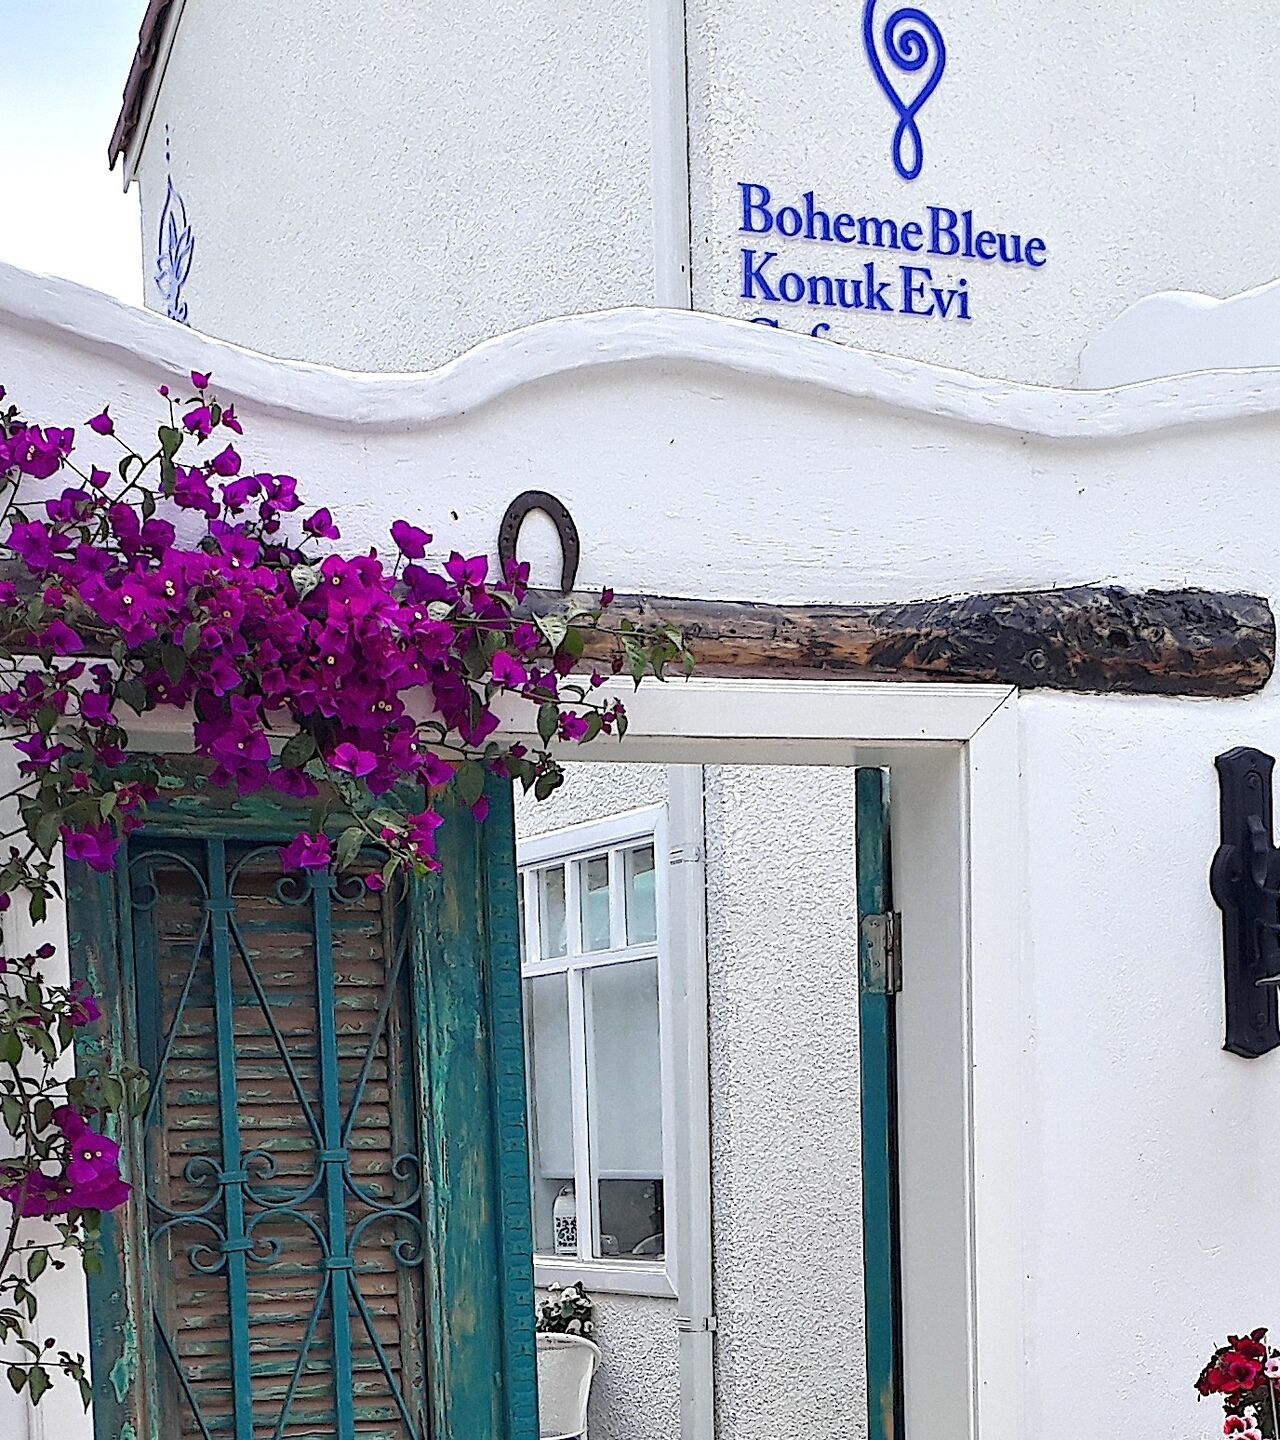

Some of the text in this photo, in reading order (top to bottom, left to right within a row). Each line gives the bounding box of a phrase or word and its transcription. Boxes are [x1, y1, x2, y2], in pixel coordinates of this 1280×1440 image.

[738, 182, 1047, 269] Boheme Bleue
[739, 248, 972, 321] Konuk Evi
